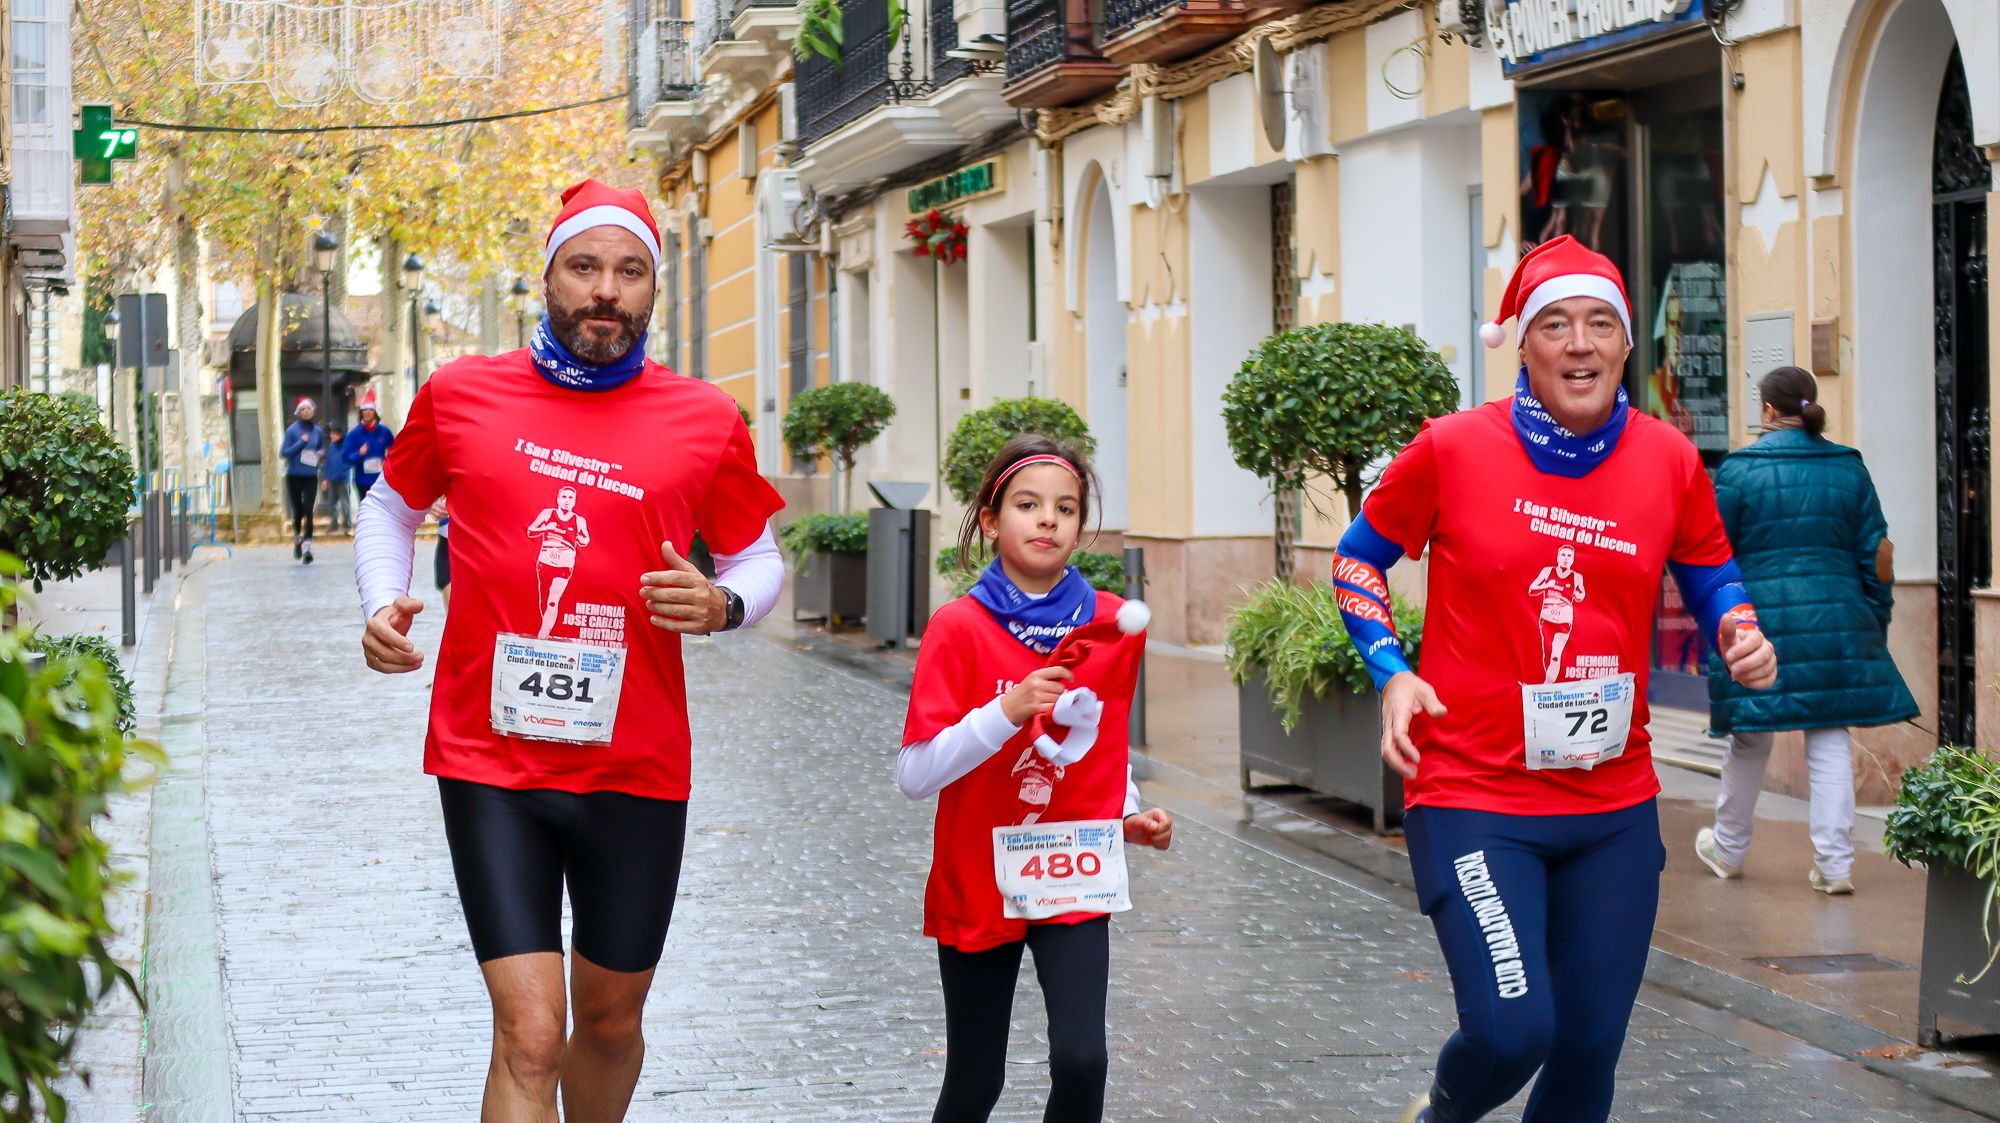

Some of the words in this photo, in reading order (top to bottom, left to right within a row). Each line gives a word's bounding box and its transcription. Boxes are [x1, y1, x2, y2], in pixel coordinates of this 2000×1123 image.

[1509, 0, 1571, 57] POWER
[514, 438, 524, 452] I
[524, 441, 551, 460] San
[551, 448, 611, 475] Silvestre
[529, 458, 578, 483] Ciudad
[577, 470, 596, 487] de
[596, 474, 645, 501] Lucena
[1513, 498, 1523, 513] I
[1522, 500, 1549, 519] San
[1549, 506, 1606, 532] Silvestre
[1530, 517, 1576, 541] Ciudad
[1575, 529, 1593, 545] de
[1593, 533, 1638, 556] Lucena
[575, 602, 626, 618] MEMORIAL
[563, 613, 588, 627] JOSE
[588, 615, 625, 630] CARLOS
[579, 626, 625, 641] HURTADO
[507, 655, 534, 665] Ciudad
[535, 658, 545, 667] de
[546, 659, 574, 670] Lucena
[508, 647, 522, 656] San
[524, 647, 558, 660] Silvestre
[1576, 655, 1619, 667] MEMORIAL
[1565, 666, 1587, 679] JOSE
[1587, 666, 1619, 680] CARLOS
[519, 671, 594, 704] 481
[1538, 694, 1552, 702] San
[1553, 690, 1585, 701] Silvestre
[1537, 701, 1564, 710] Ciudad
[1565, 700, 1574, 708] de
[1574, 698, 1599, 707] Lucena
[1565, 708, 1608, 737] 72
[1007, 843, 1034, 852] Ciudad
[1022, 833, 1057, 843] Silvestre
[1021, 852, 1100, 880] 480
[1453, 850, 1498, 902] LUCENA
[1470, 895, 1521, 963] MARATON
[1494, 958, 1528, 999] CLUB
